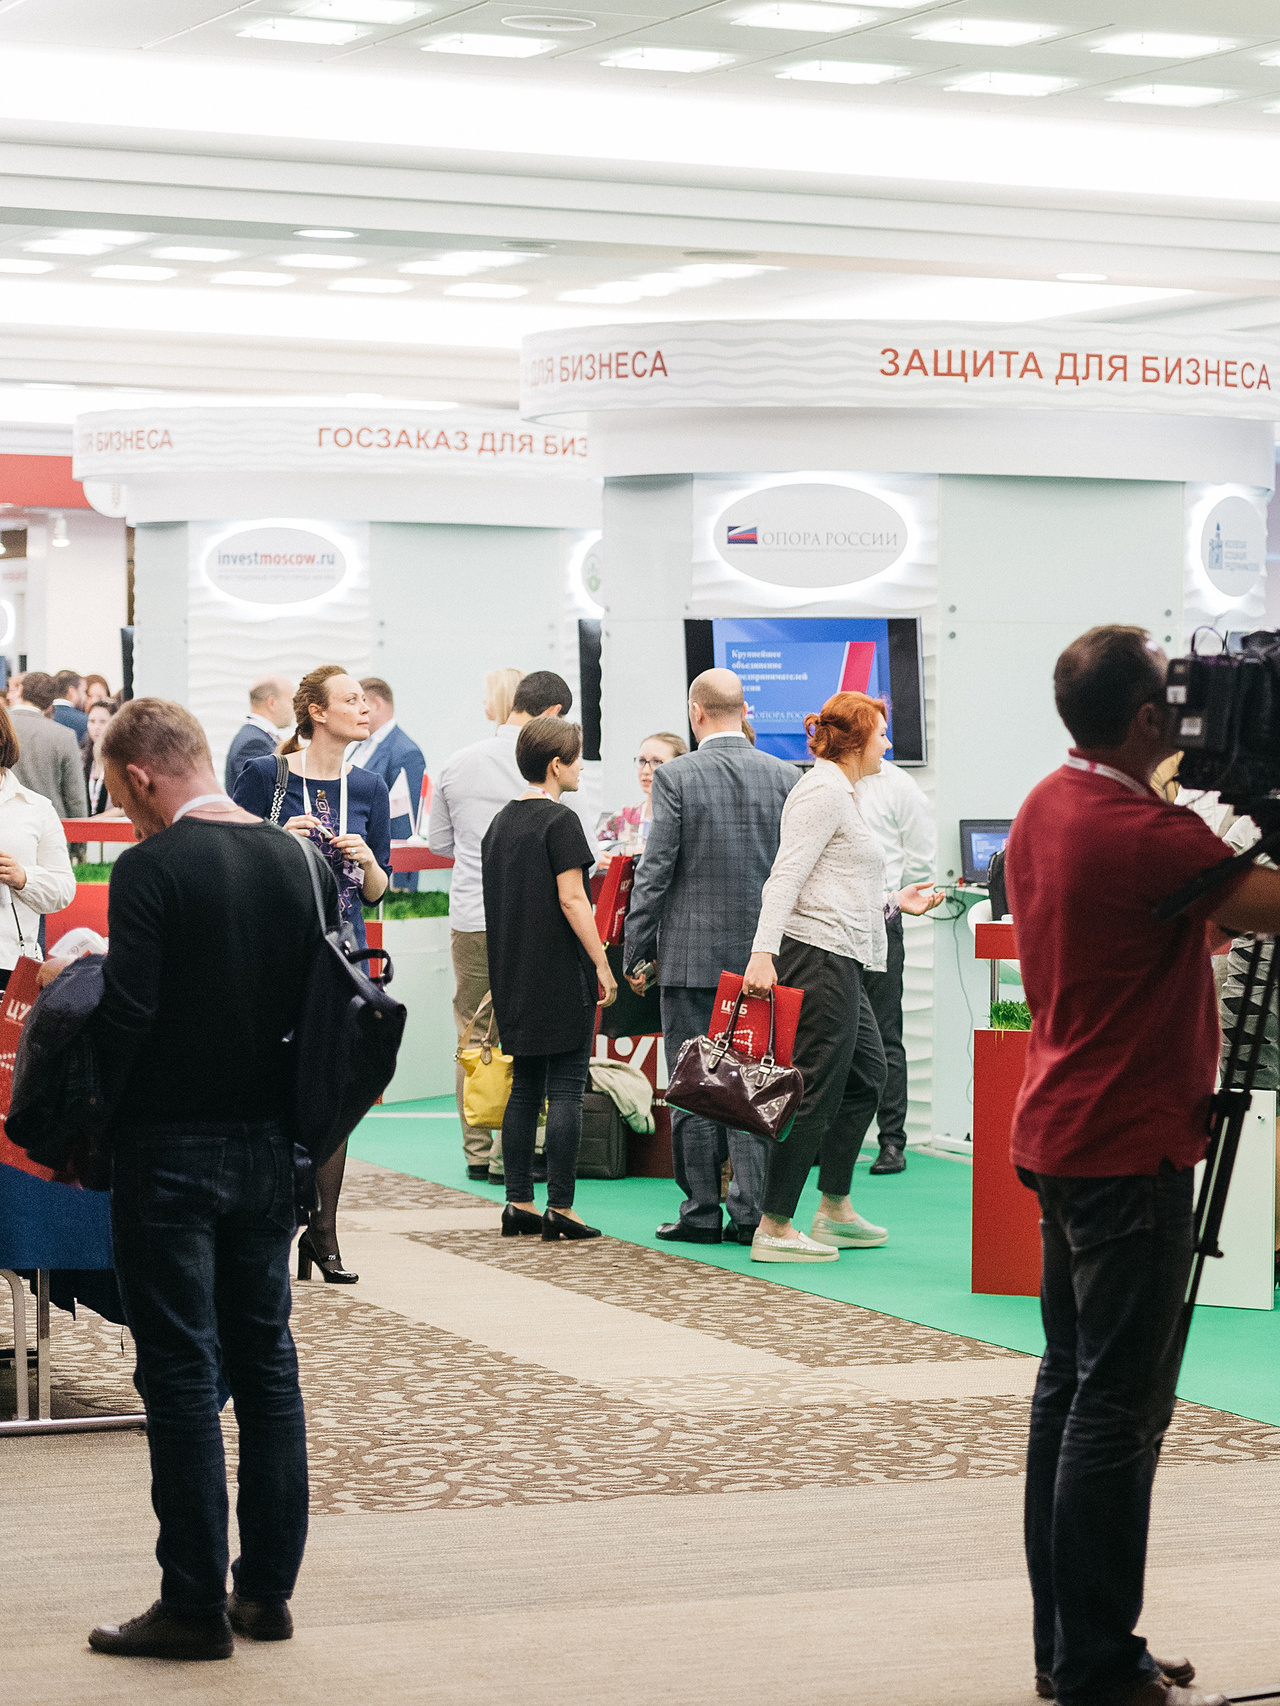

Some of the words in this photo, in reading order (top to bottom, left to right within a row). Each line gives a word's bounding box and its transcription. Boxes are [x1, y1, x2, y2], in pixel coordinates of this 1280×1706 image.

[559, 350, 668, 383] БИЗНЕСА
[879, 347, 1043, 384] ЗАЩИТА
[1055, 352, 1128, 386] ДЛЯ
[1141, 356, 1271, 391] БИЗНЕСА
[96, 429, 173, 452] БИЗНЕСА
[318, 427, 468, 451] ГОСЗАКАЗ
[478, 432, 533, 456] ДЛЯ
[761, 531, 822, 546] ОПОРА
[826, 531, 898, 546] РОССИИ
[218, 550, 336, 565] investmoscow.ru
[731, 649, 782, 660] Крупнейшее
[6, 998, 32, 1021] ЦУ
